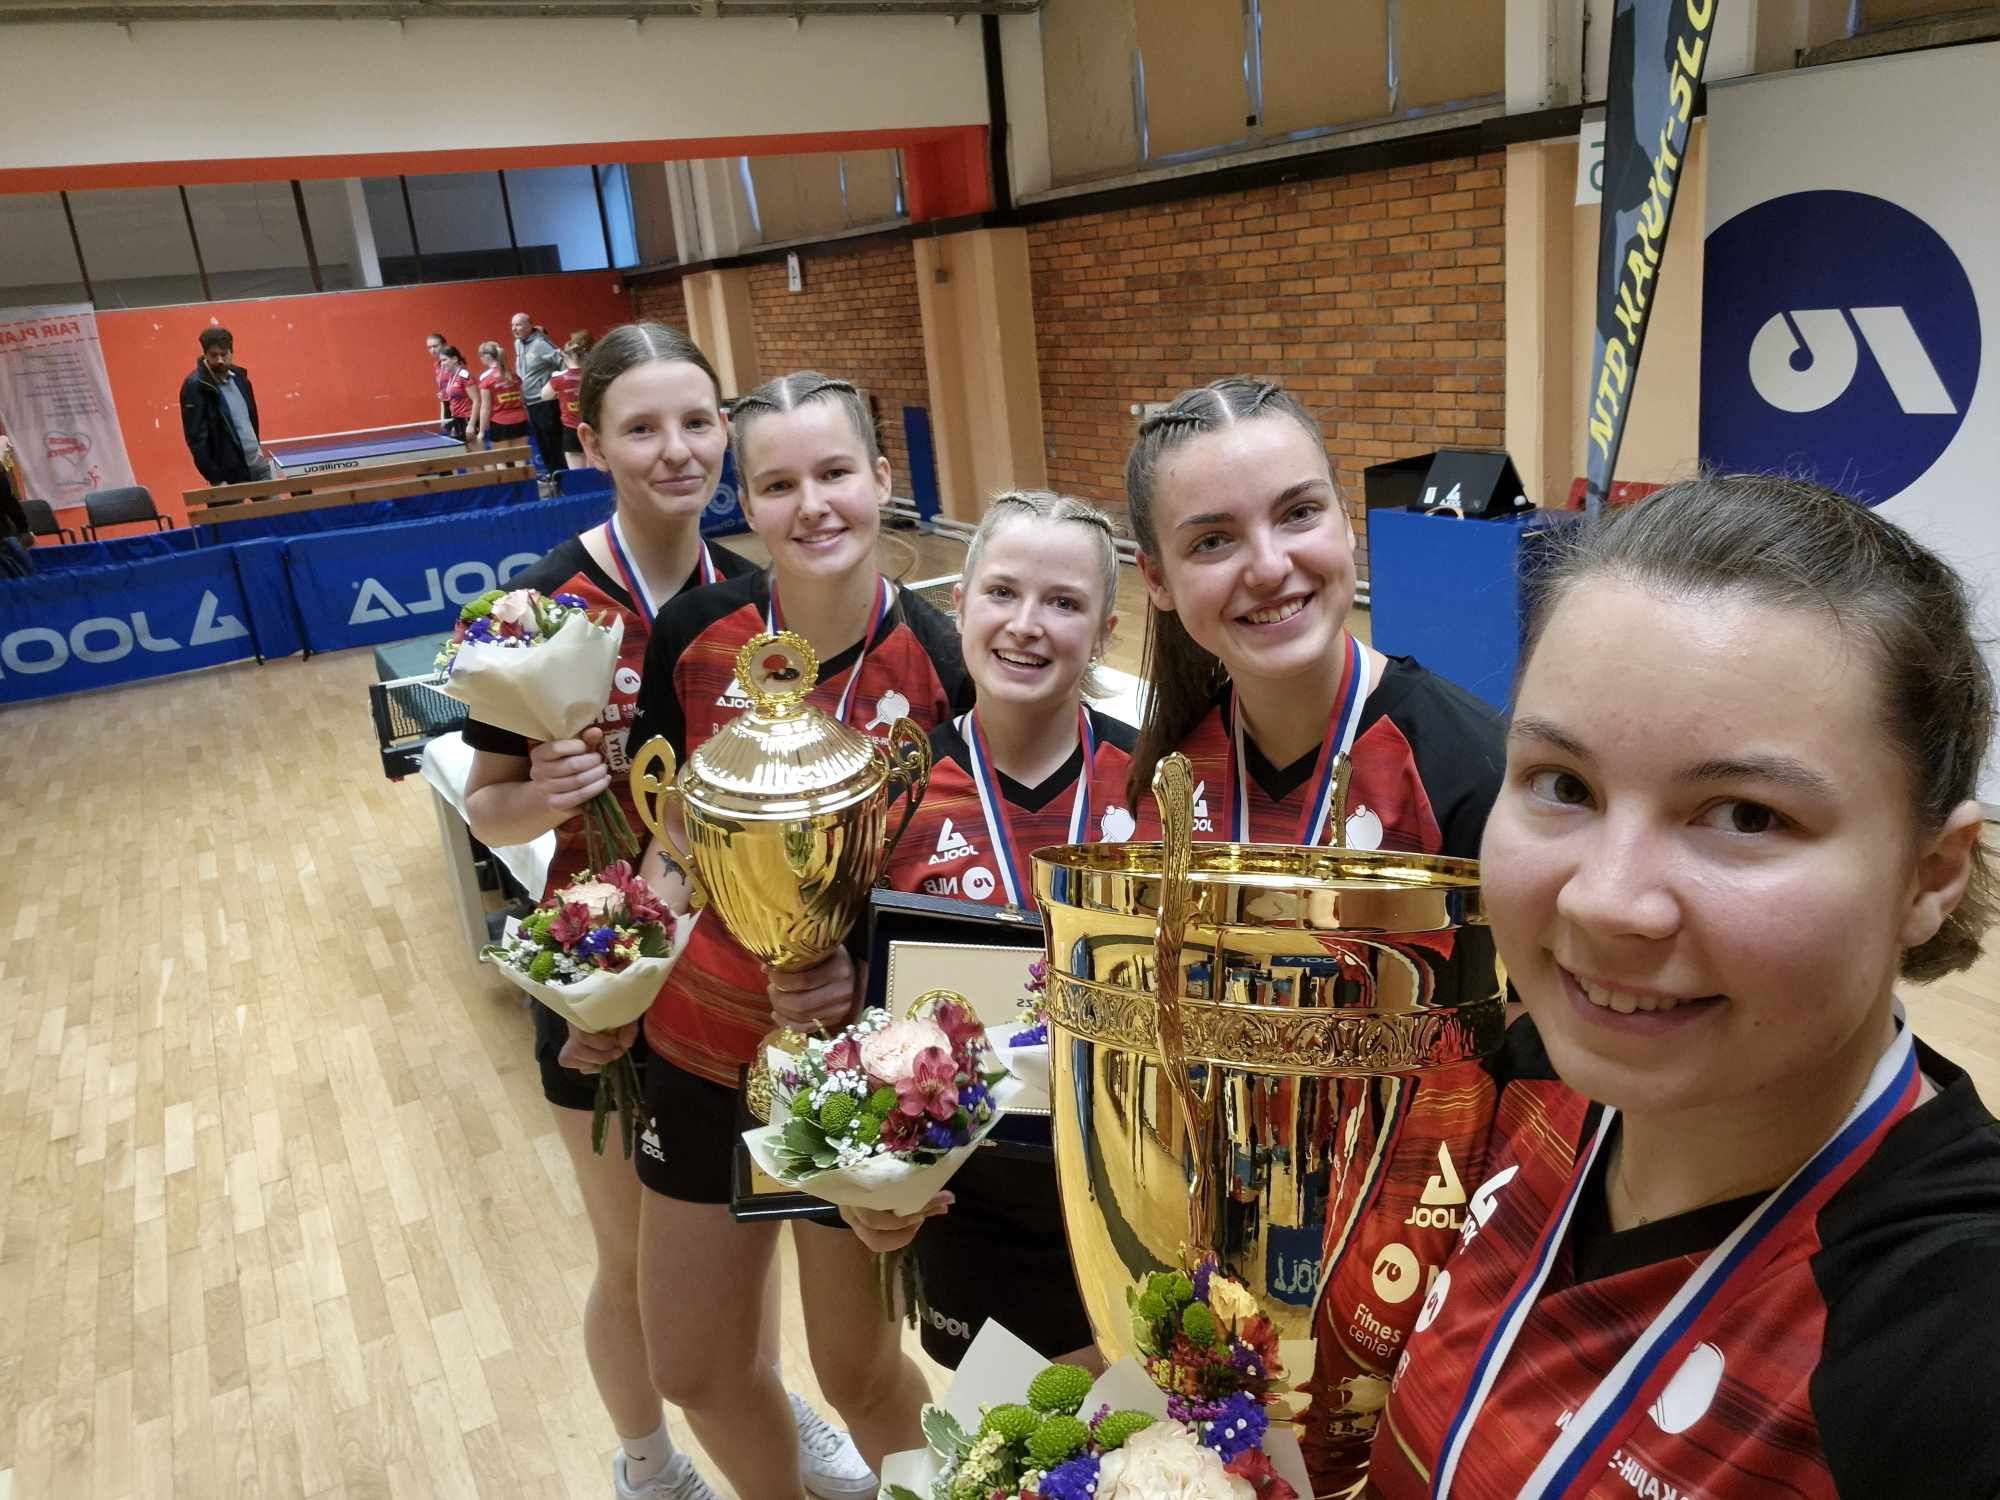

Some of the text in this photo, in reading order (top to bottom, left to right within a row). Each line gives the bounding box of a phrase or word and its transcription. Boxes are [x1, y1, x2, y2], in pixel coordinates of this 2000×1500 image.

[1590, 338, 1628, 458] NTD
[1404, 1206, 1460, 1229] JOOL
[1353, 1303, 1402, 1343] Fitnes
[1348, 1326, 1396, 1359] center
